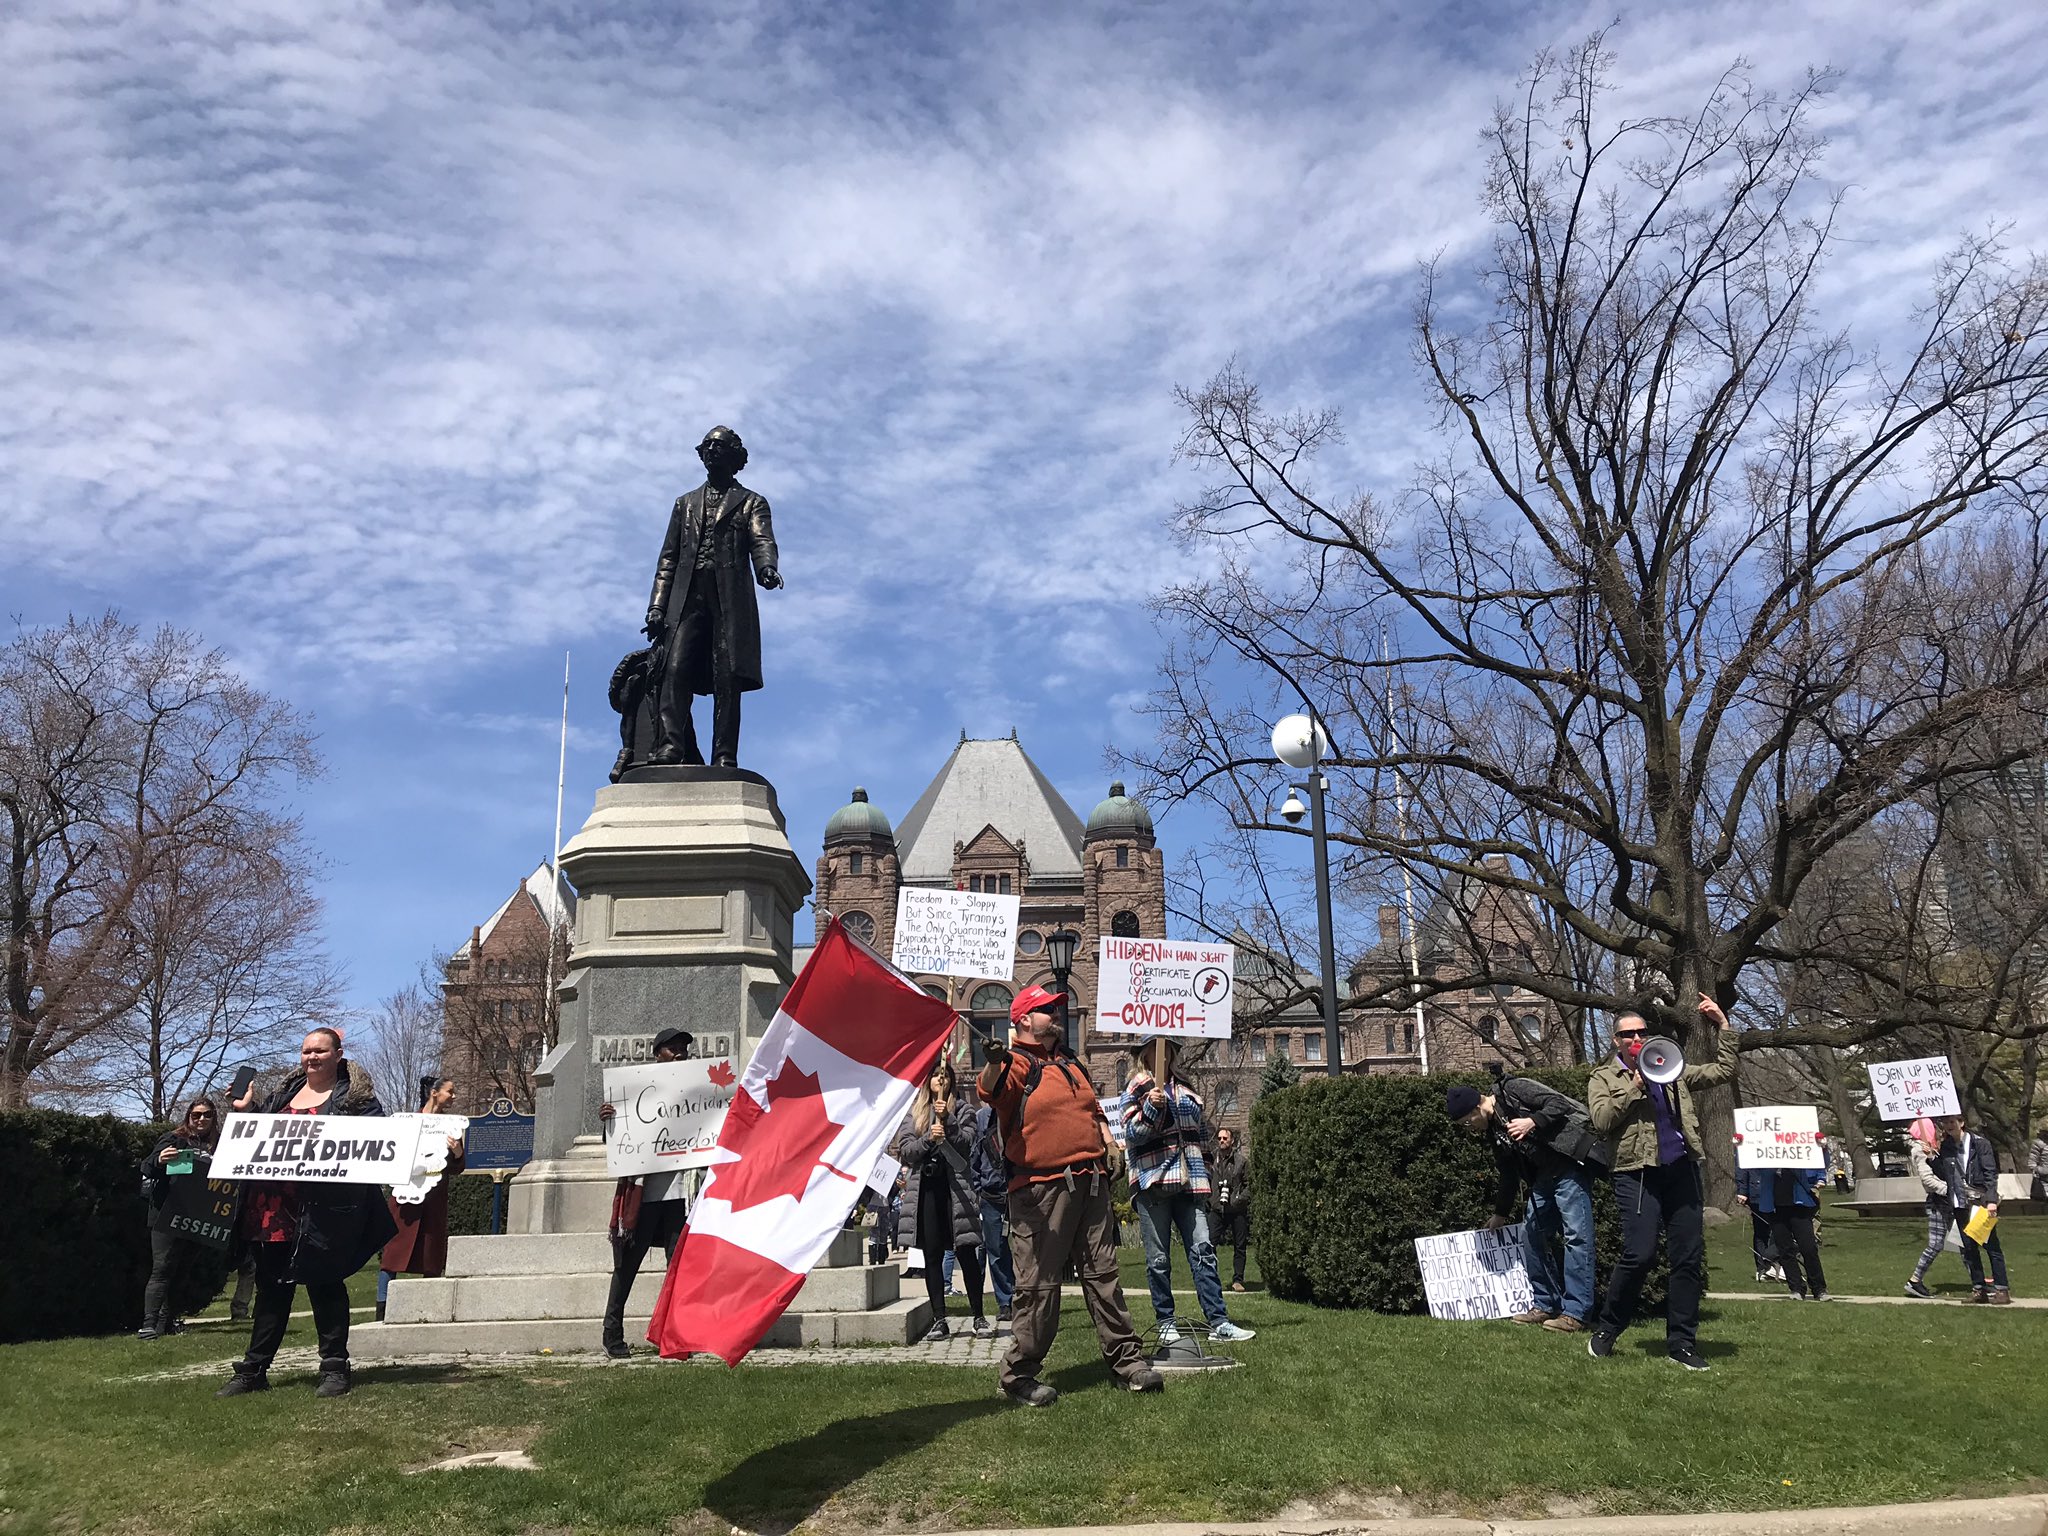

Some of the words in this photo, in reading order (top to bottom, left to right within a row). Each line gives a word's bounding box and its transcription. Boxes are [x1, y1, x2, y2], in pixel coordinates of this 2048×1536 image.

[906, 891, 942, 904] Freedom
[906, 906, 922, 918] But
[926, 906, 952, 919] Since
[905, 919, 921, 932] The
[926, 921, 944, 938] Only
[949, 921, 1007, 938] Guaranteed
[899, 931, 937, 947] Byproduct
[942, 934, 954, 945] Of
[958, 935, 980, 946] Those
[983, 937, 999, 948] Who
[895, 943, 920, 954] Insist
[922, 945, 932, 955] On
[934, 945, 941, 955] A
[944, 944, 975, 958] Perfect
[979, 948, 1005, 961] World
[1106, 940, 1162, 962] HIDDEN
[1163, 949, 1172, 959] IN
[1200, 951, 1229, 963] SIGHT
[899, 954, 950, 973] FREEDOM
[970, 958, 987, 966] Have
[979, 967, 988, 975] To
[600, 1036, 730, 1062] MACDALD
[1876, 1066, 1904, 1086] SIGN
[1907, 1064, 1922, 1077] UP
[1926, 1063, 1950, 1078] HERE
[1904, 1080, 1922, 1095] DIE
[1928, 1079, 1948, 1091] FOR
[1885, 1101, 1900, 1112] THE
[231, 1120, 258, 1139] NO
[269, 1119, 325, 1139] MORE
[1745, 1117, 1781, 1132] CURE
[616, 1133, 645, 1154] for
[1775, 1131, 1814, 1144] WORSE
[250, 1139, 396, 1162] LOCKDOWNS
[1756, 1145, 1812, 1160] DISEASE?
[232, 1162, 348, 1178] #ReopenCanada
[213, 1201, 232, 1216] IS
[1416, 1235, 1463, 1258] WELCOME
[1462, 1233, 1477, 1251] TO
[1476, 1231, 1497, 1250] THE
[1429, 1274, 1496, 1301] GOVERNMENT
[1465, 1294, 1501, 1320] MEDIA
